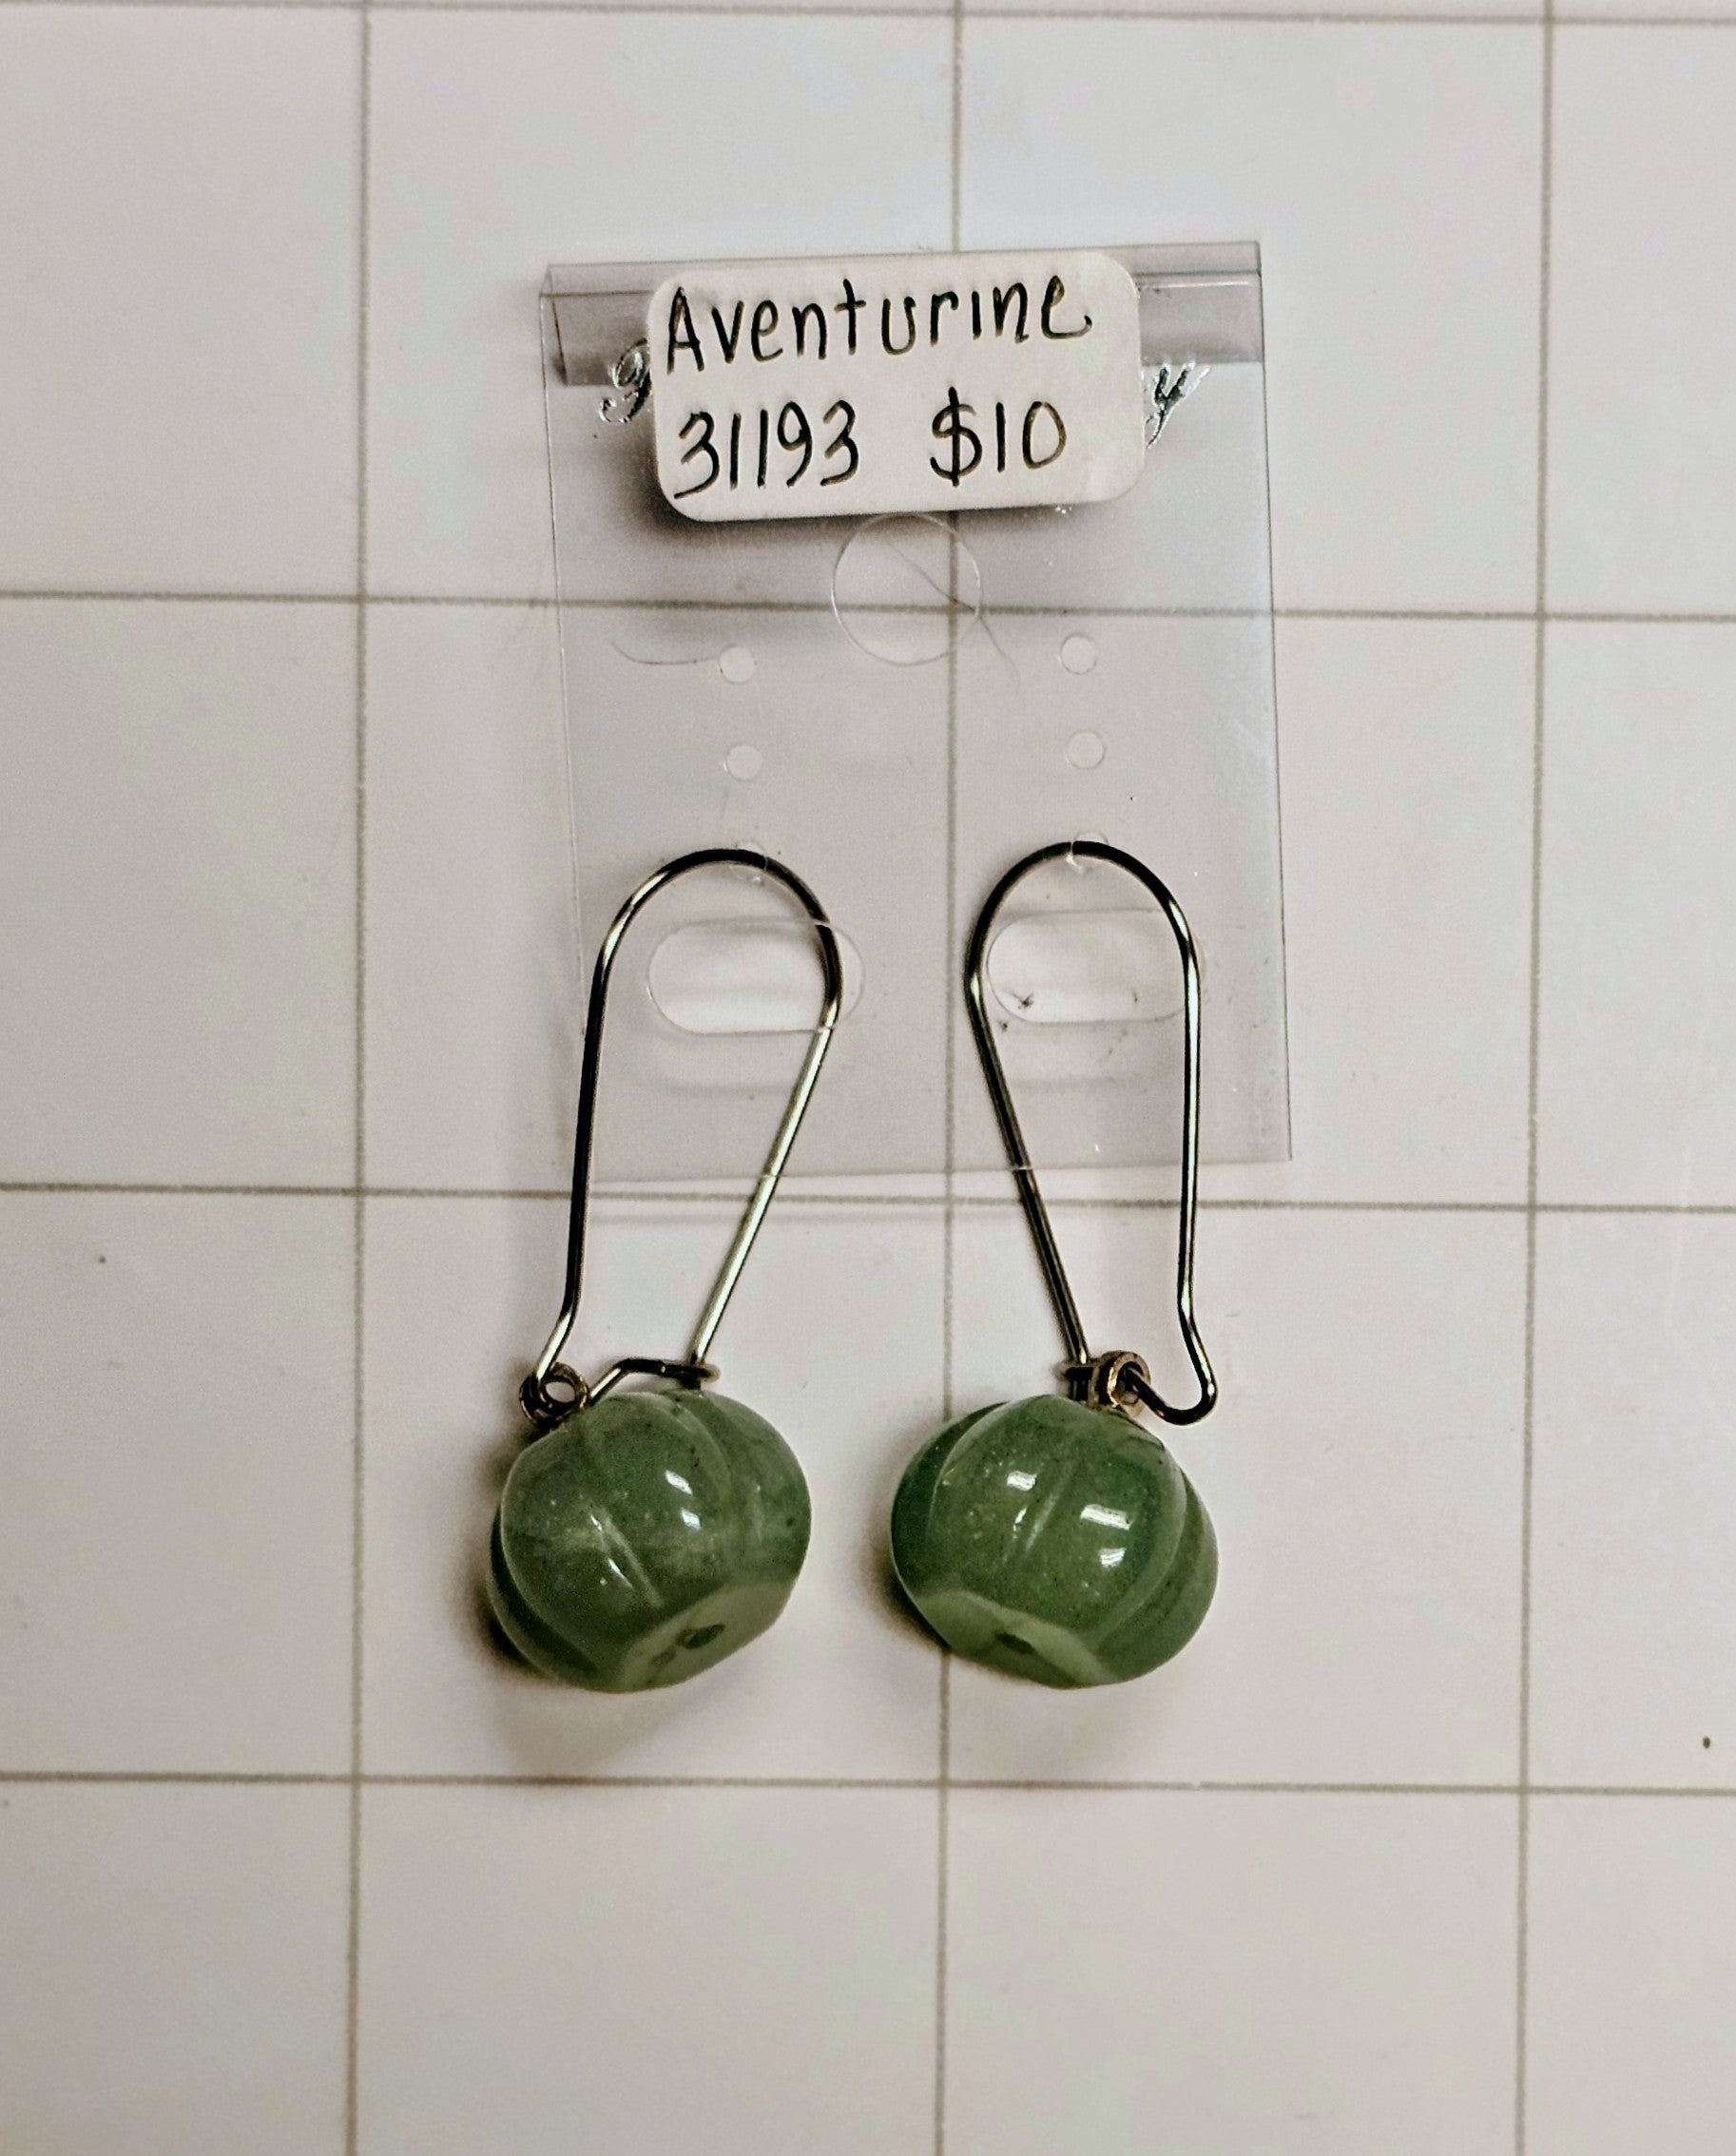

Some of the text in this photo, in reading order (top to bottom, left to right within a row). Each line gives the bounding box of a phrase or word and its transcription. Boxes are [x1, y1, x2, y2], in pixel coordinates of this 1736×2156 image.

[665, 272, 1094, 375] Aventurine
[672, 398, 861, 501] 31193
[928, 385, 1068, 488] $10
